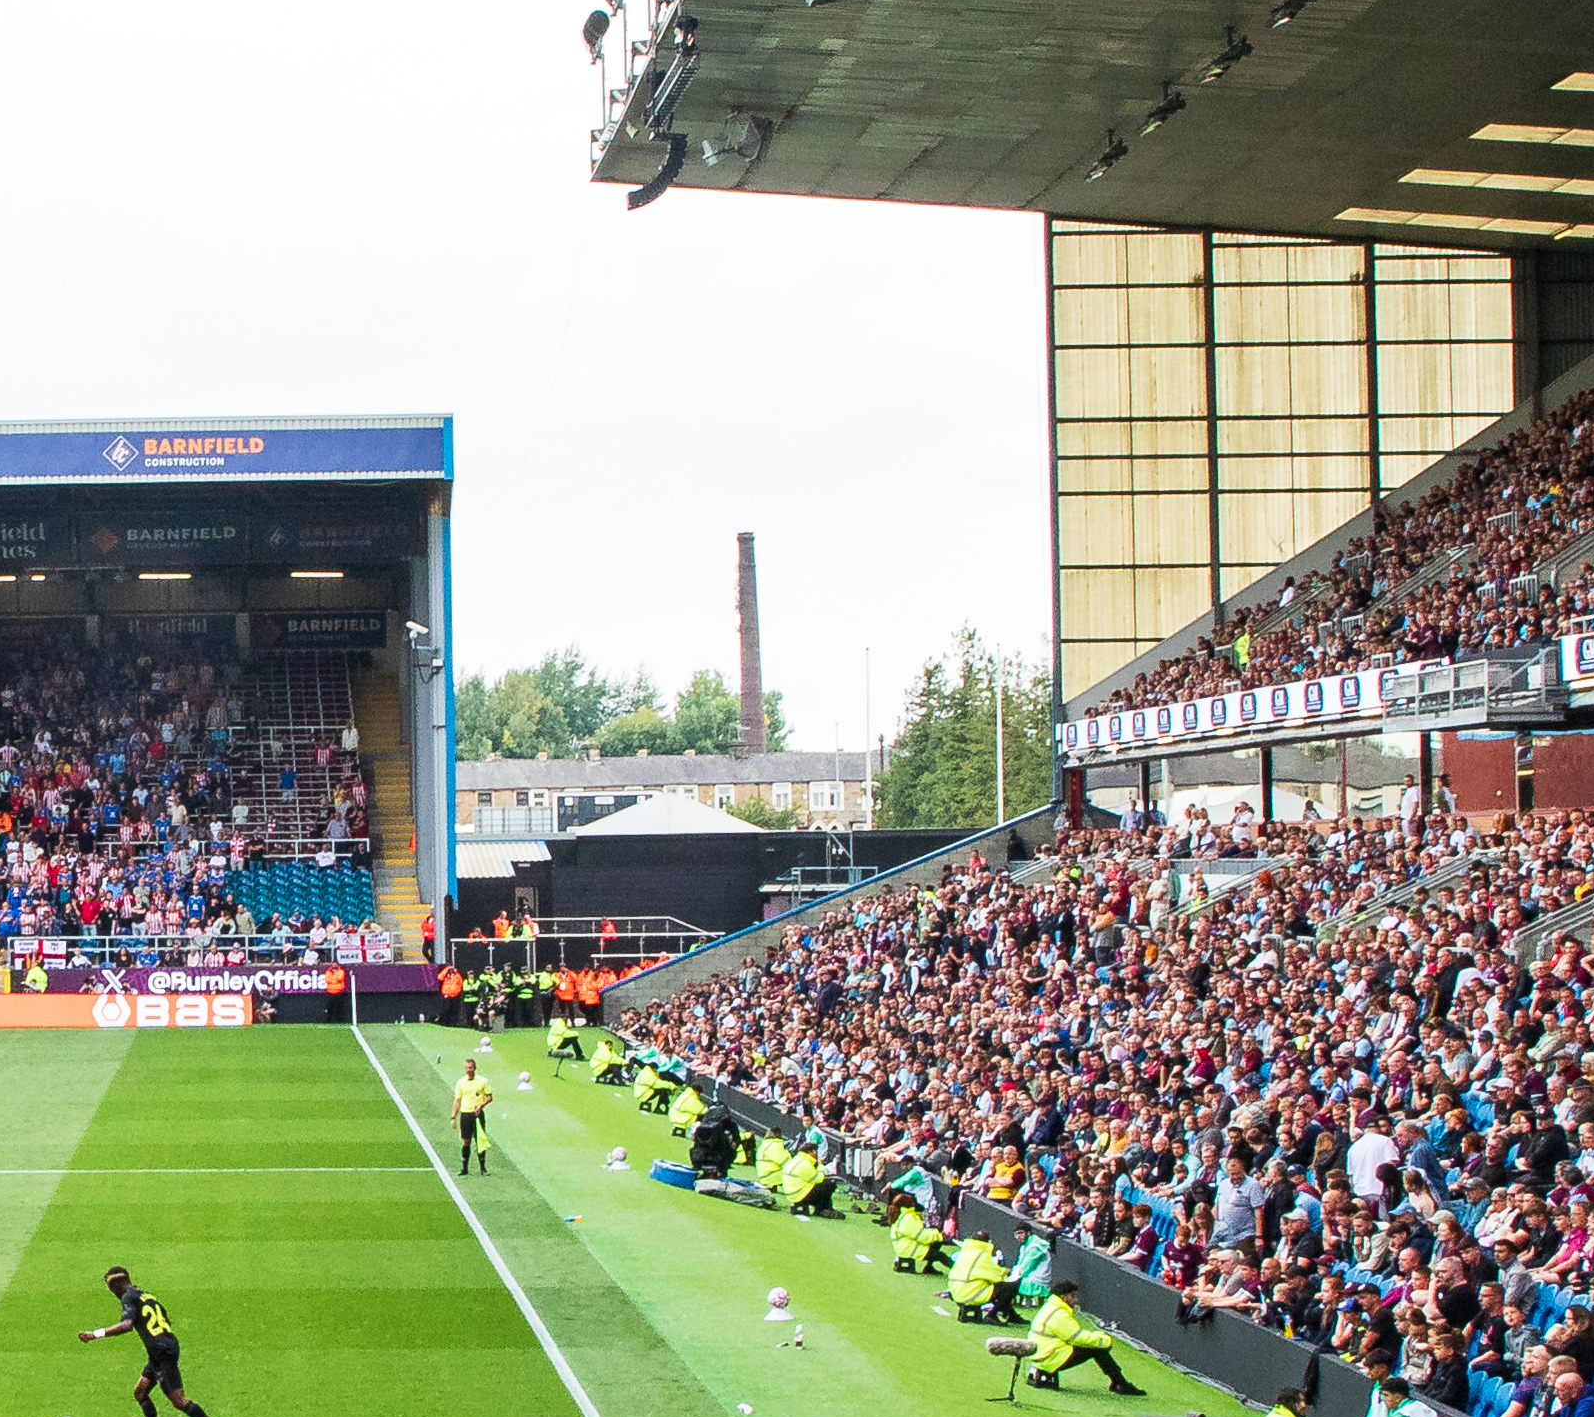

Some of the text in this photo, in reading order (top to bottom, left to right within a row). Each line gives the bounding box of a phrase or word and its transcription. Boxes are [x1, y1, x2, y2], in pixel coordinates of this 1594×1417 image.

[143, 437, 265, 456] BARNFIELD
[144, 456, 225, 468] CONSTRUCTION
[126, 526, 236, 542] BARNFIELD
[287, 618, 381, 633] BARNFIELD
[148, 969, 329, 993] @BurnleyOfficia
[142, 1304, 172, 1337] 24
